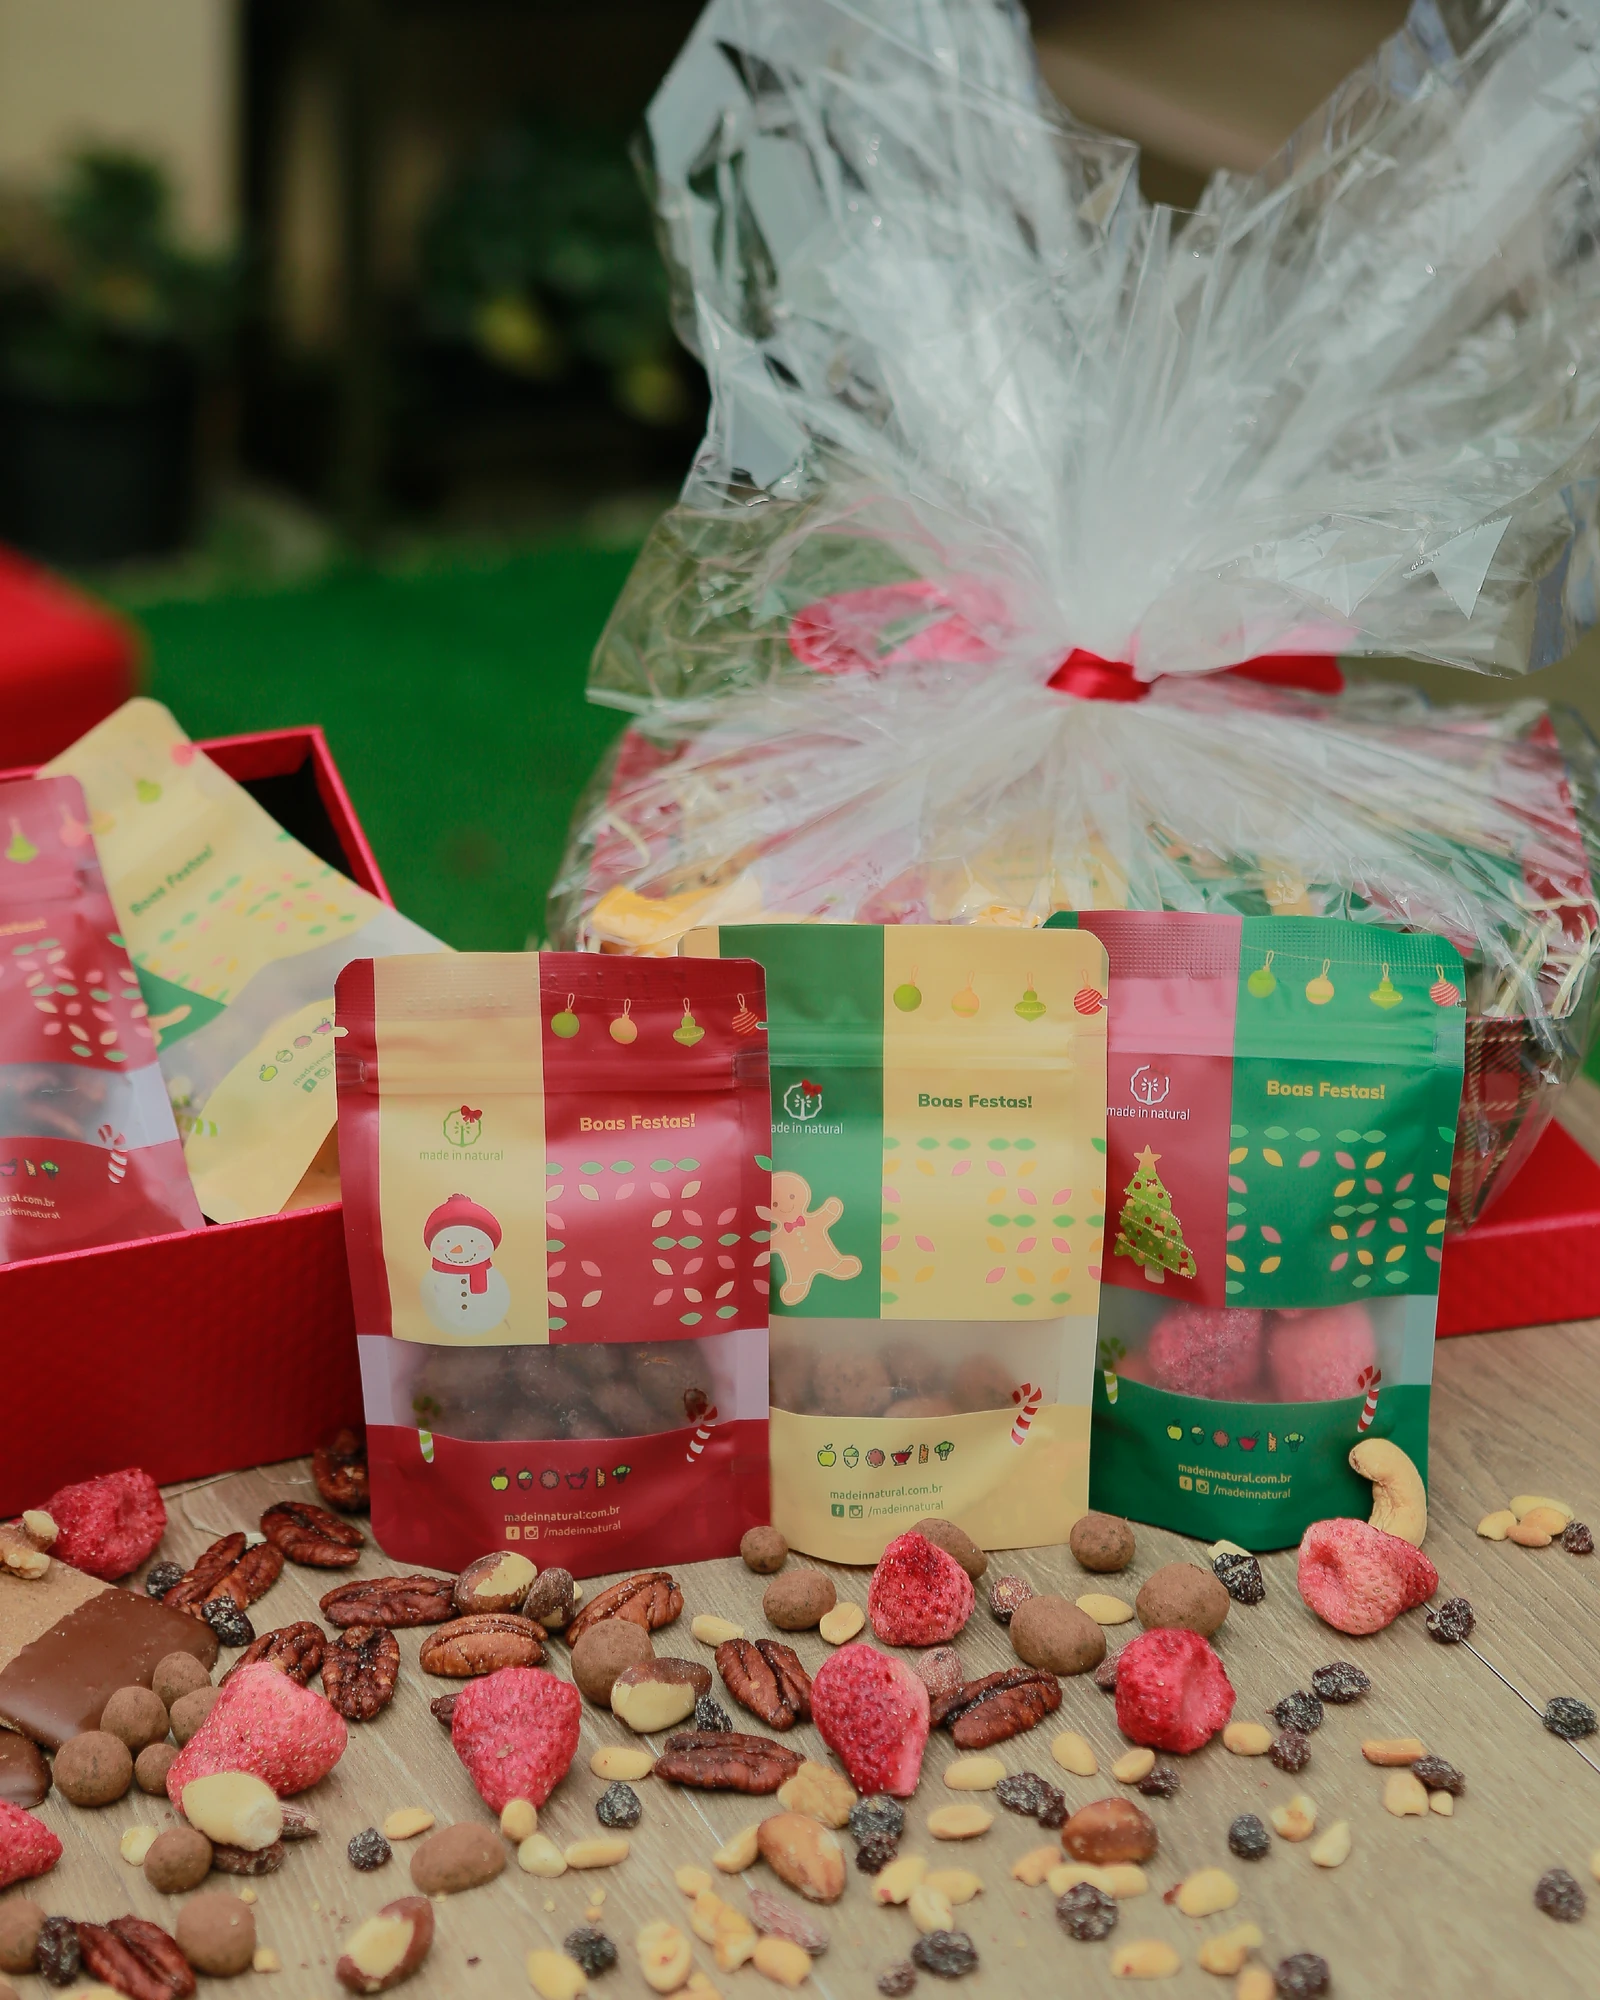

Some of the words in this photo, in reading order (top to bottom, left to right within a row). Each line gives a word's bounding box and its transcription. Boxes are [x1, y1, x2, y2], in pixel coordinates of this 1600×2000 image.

[1267, 1080, 1314, 1097] Boas
[1319, 1082, 1385, 1100] Festas!
[918, 1093, 963, 1108] Boas
[969, 1094, 1032, 1109] Festas!
[1106, 1105, 1136, 1117] made
[1138, 1106, 1148, 1118] in
[1150, 1108, 1190, 1120] natural
[580, 1117, 626, 1132] Boas
[631, 1113, 696, 1130] Festas!
[771, 1122, 790, 1134] ade
[792, 1122, 802, 1134] in
[804, 1122, 843, 1135] natural
[419, 1149, 449, 1161] made
[452, 1149, 462, 1161] in
[464, 1149, 504, 1161] natural
[0, 1193, 56, 1208] ural.com.br
[0, 1207, 61, 1220] adeinnatural
[1178, 1464, 1292, 1484] madeinnatural.com.br
[830, 1483, 943, 1500] madeinnatural.com.br
[1213, 1484, 1291, 1500] /madeinnatural
[504, 1505, 621, 1523] madeinnatural.com.br
[867, 1500, 944, 1518] /madeinnatural
[543, 1520, 622, 1539] /madeinnatural
